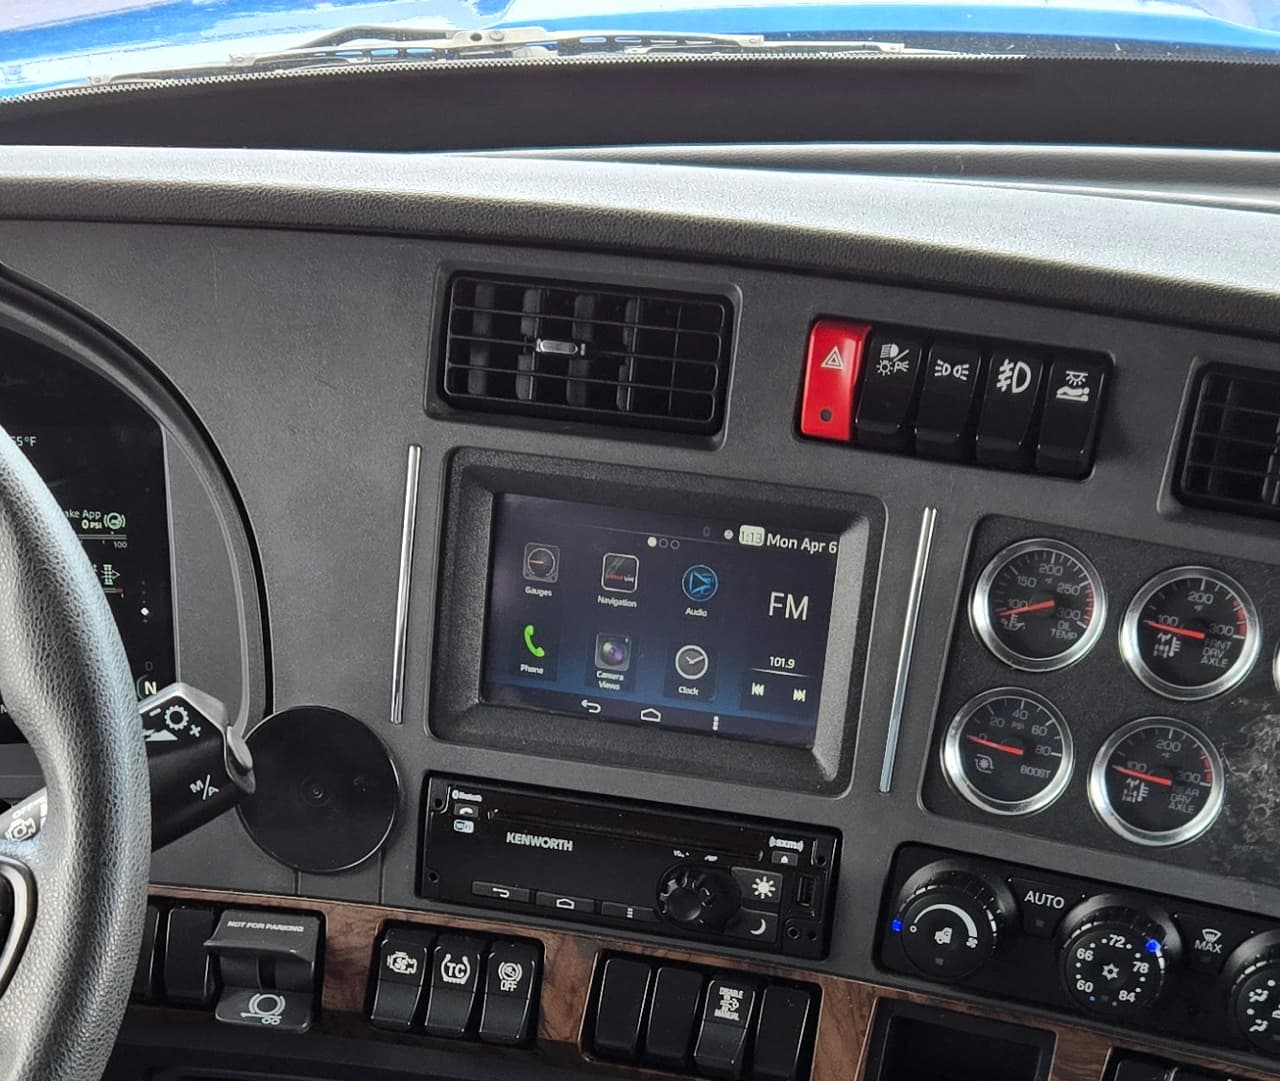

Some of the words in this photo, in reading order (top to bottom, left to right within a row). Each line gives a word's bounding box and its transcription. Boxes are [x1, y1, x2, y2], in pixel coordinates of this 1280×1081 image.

[82, 509, 101, 520] App
[81, 519, 89, 529] 0
[90, 521, 103, 529] PSI
[766, 533, 798, 549] Mon
[801, 537, 826, 554] Apr
[828, 541, 838, 554] 6
[1038, 563, 1064, 577] 200
[1017, 575, 1037, 588] 150
[524, 586, 553, 597] Gauges
[1056, 582, 1081, 596] 250
[597, 595, 637, 608] Navigation
[1187, 590, 1214, 605] 200
[685, 607, 708, 617] Audio
[768, 591, 809, 621] FM
[1056, 607, 1081, 620] 300
[1057, 620, 1071, 631] OIL
[1208, 623, 1234, 636] 300
[1050, 628, 1078, 640] TEMP
[1202, 647, 1226, 659] DRV
[769, 656, 795, 669] 101.9
[1200, 656, 1229, 668] AXLE
[596, 670, 624, 681] Camera
[144, 680, 157, 694] N
[598, 680, 620, 691] Views
[678, 686, 699, 696] Clock
[1012, 709, 1028, 720] 40
[989, 716, 1005, 728] 20
[1031, 725, 1048, 736] 60
[1155, 739, 1181, 752] 200
[1020, 764, 1052, 778] BOOST
[1168, 802, 1196, 814] AXLE
[506, 831, 573, 851] KENWORTH
[1024, 890, 1065, 909] AUTO
[227, 920, 246, 928] NOT
[265, 923, 305, 932] PARKING
[1108, 934, 1126, 948] 72
[1194, 939, 1223, 954] MAX
[1076, 947, 1094, 961] 66
[446, 962, 466, 978] TC
[1132, 961, 1150, 974] 78
[500, 980, 518, 992] OFF
[1076, 979, 1094, 993] 60
[1118, 990, 1136, 1003] 84
